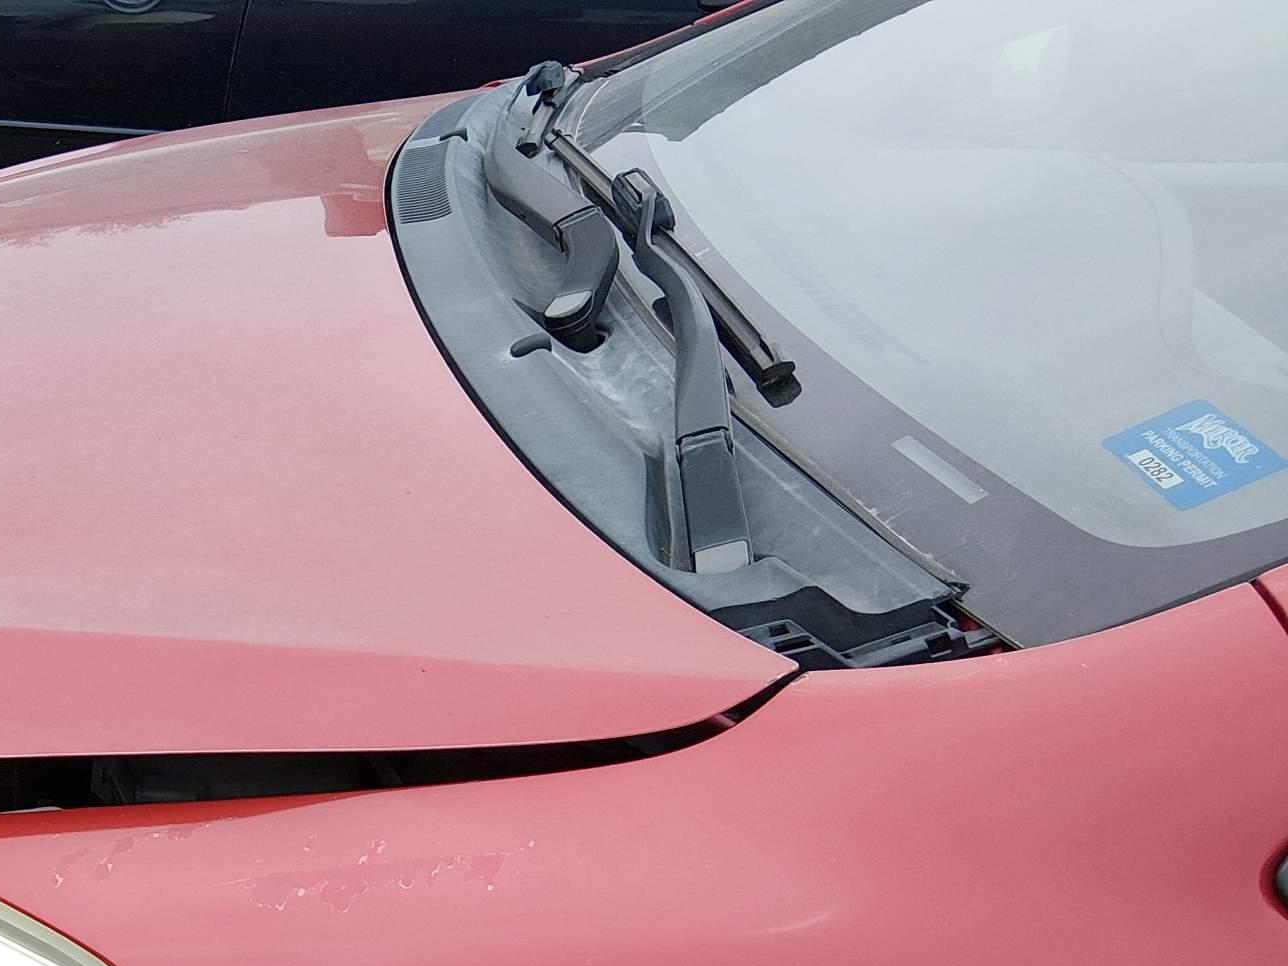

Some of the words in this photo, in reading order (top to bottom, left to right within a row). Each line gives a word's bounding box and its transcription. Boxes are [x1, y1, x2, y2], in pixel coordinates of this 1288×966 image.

[1138, 457, 1174, 482] 0282
[1141, 430, 1184, 463] PARKING
[1177, 459, 1219, 488] PERMIT
[1162, 427, 1227, 480] TRANSPORTATION
